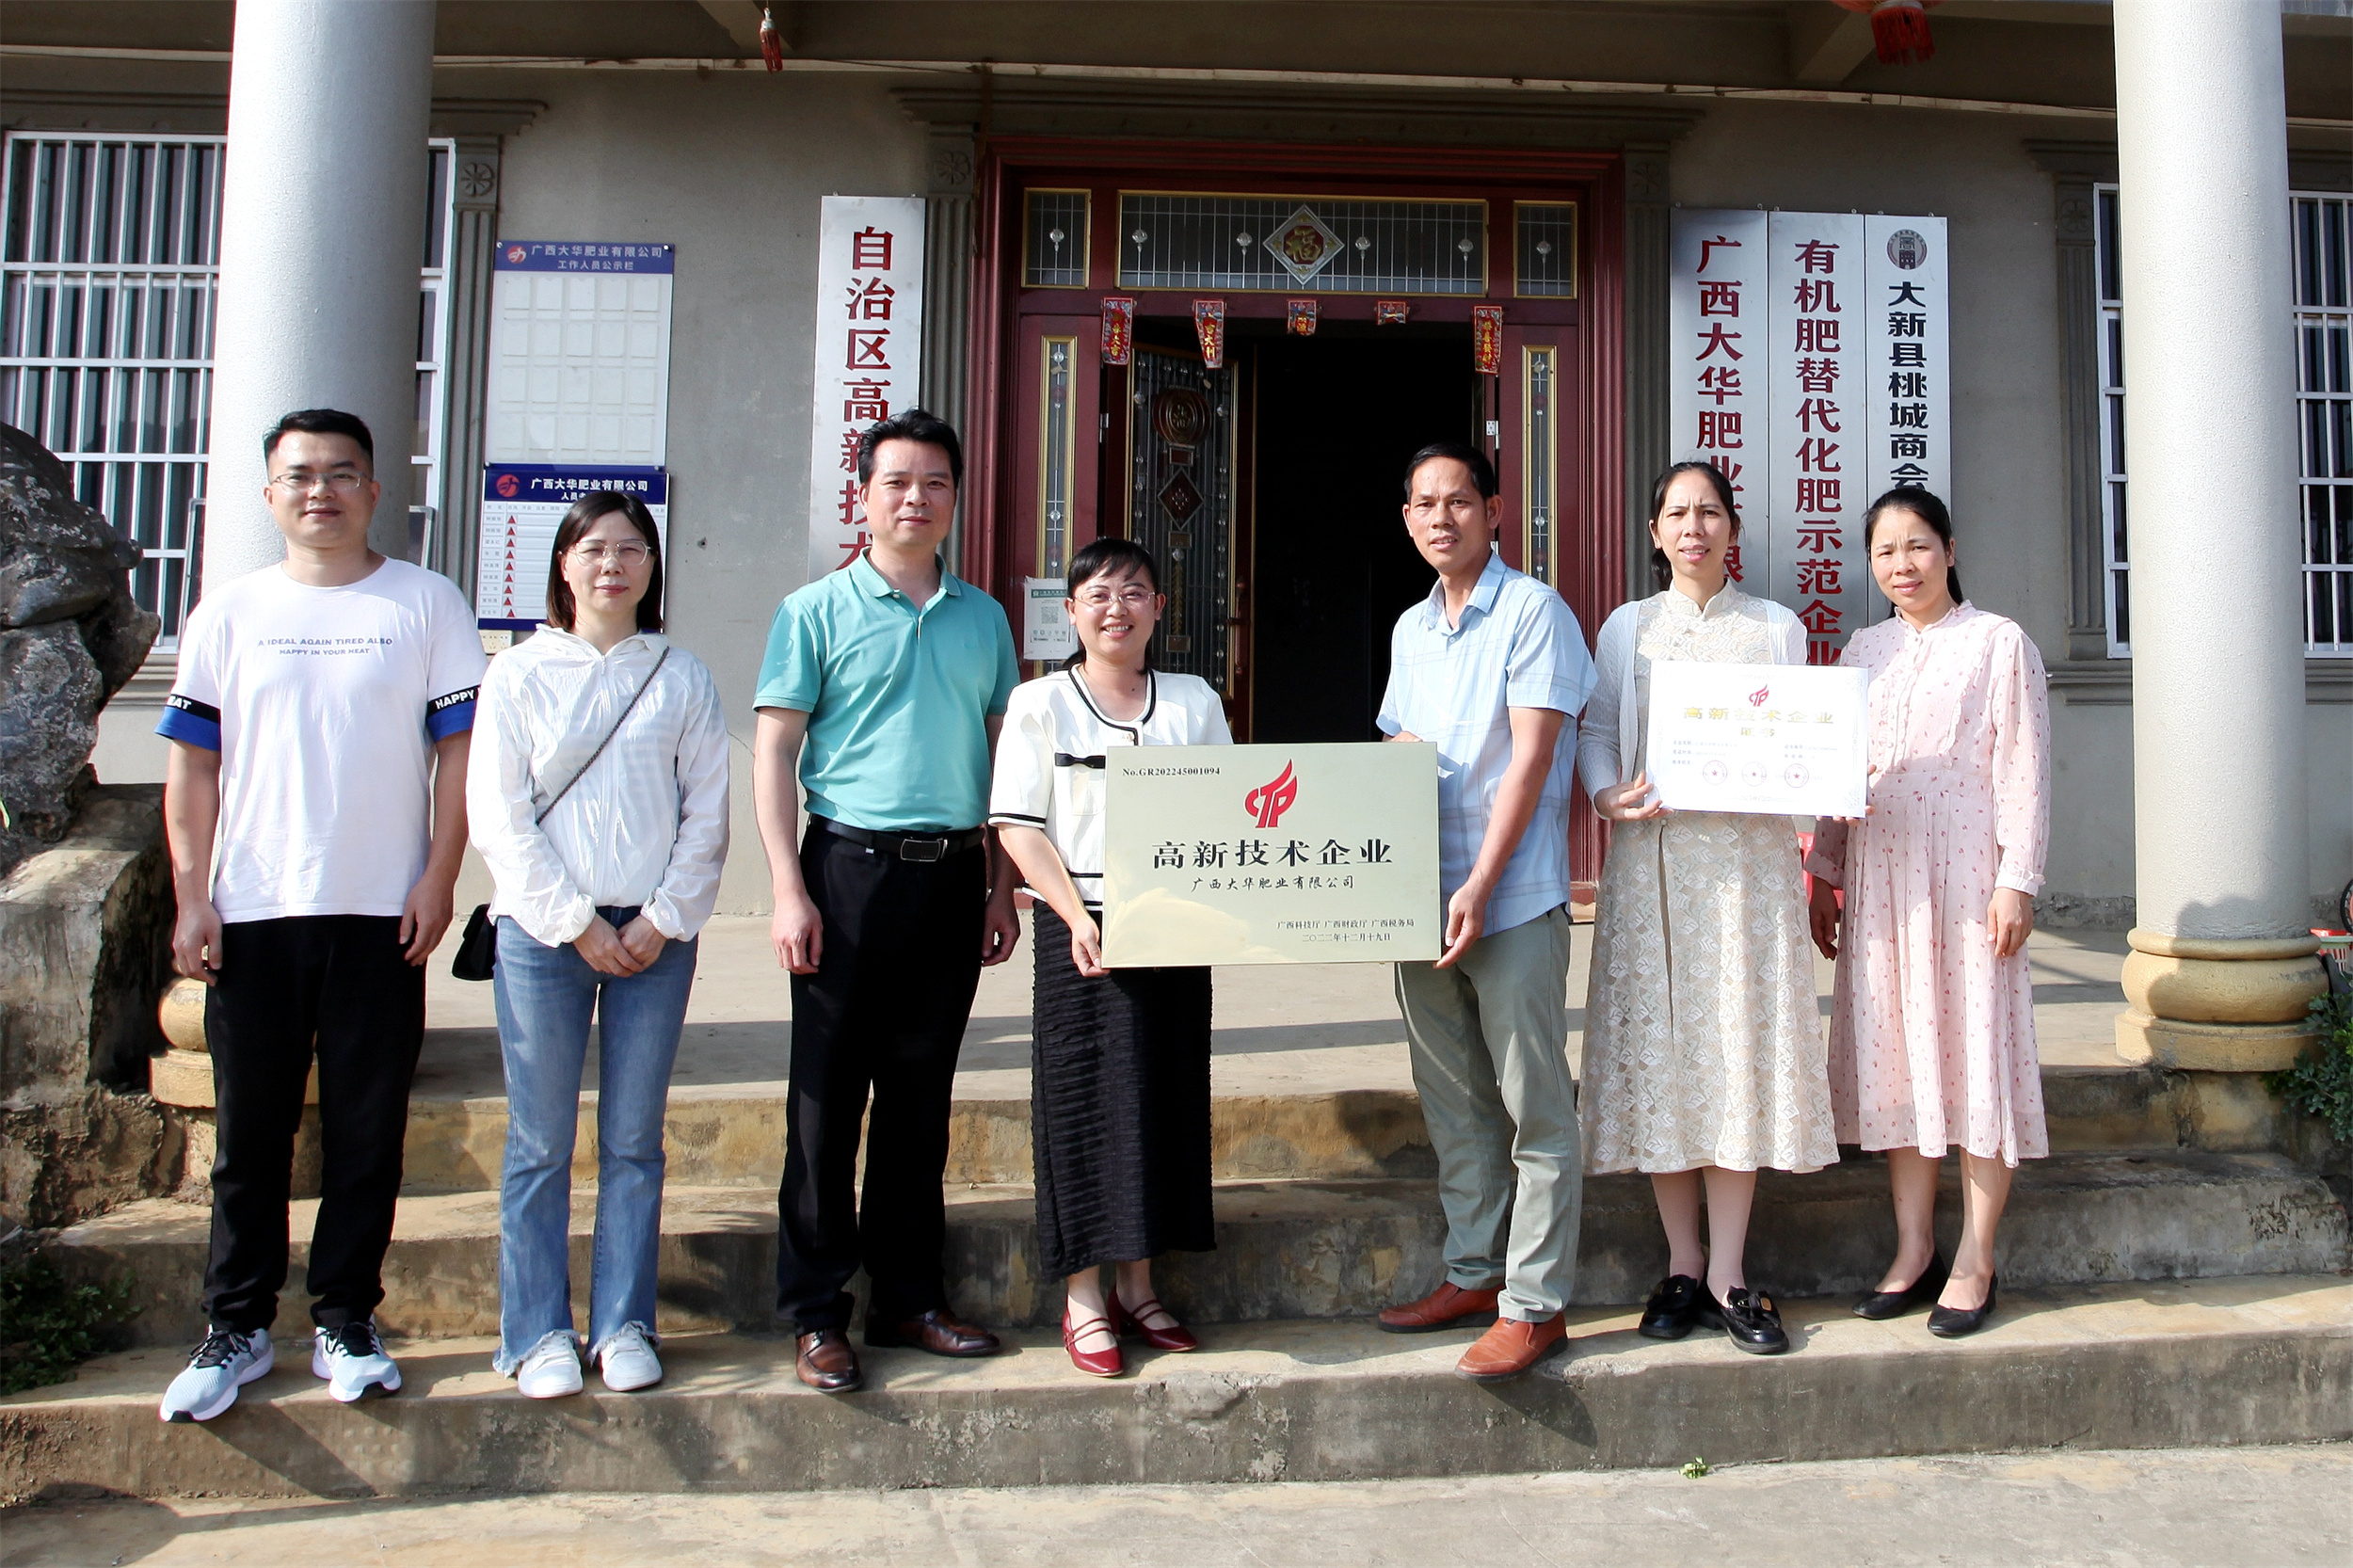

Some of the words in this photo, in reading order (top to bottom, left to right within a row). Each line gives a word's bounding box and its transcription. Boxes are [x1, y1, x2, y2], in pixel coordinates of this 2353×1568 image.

[531, 245, 663, 258] 广西大华肥业有限公司
[557, 260, 634, 271] 工作人员公示栏
[1887, 280, 1929, 489] 大新县桃城商会
[1696, 234, 1744, 583] 广西大华肥
[1793, 238, 1844, 664] 有机肥替代化肥示范企业
[531, 478, 648, 491] 广西大华肥业有限公司
[435, 689, 475, 710] HAPPY
[1683, 706, 1834, 724] 高新技术企业
[1122, 767, 1221, 776] No.GR202245001094
[1152, 839, 1393, 870] 高新技术企业
[1191, 874, 1355, 892] 广西大华肥业有限公司
[1277, 920, 1321, 930] 广西科技厅
[1324, 919, 1368, 929] 广西财政厅
[1371, 918, 1415, 928] 广西税务局
